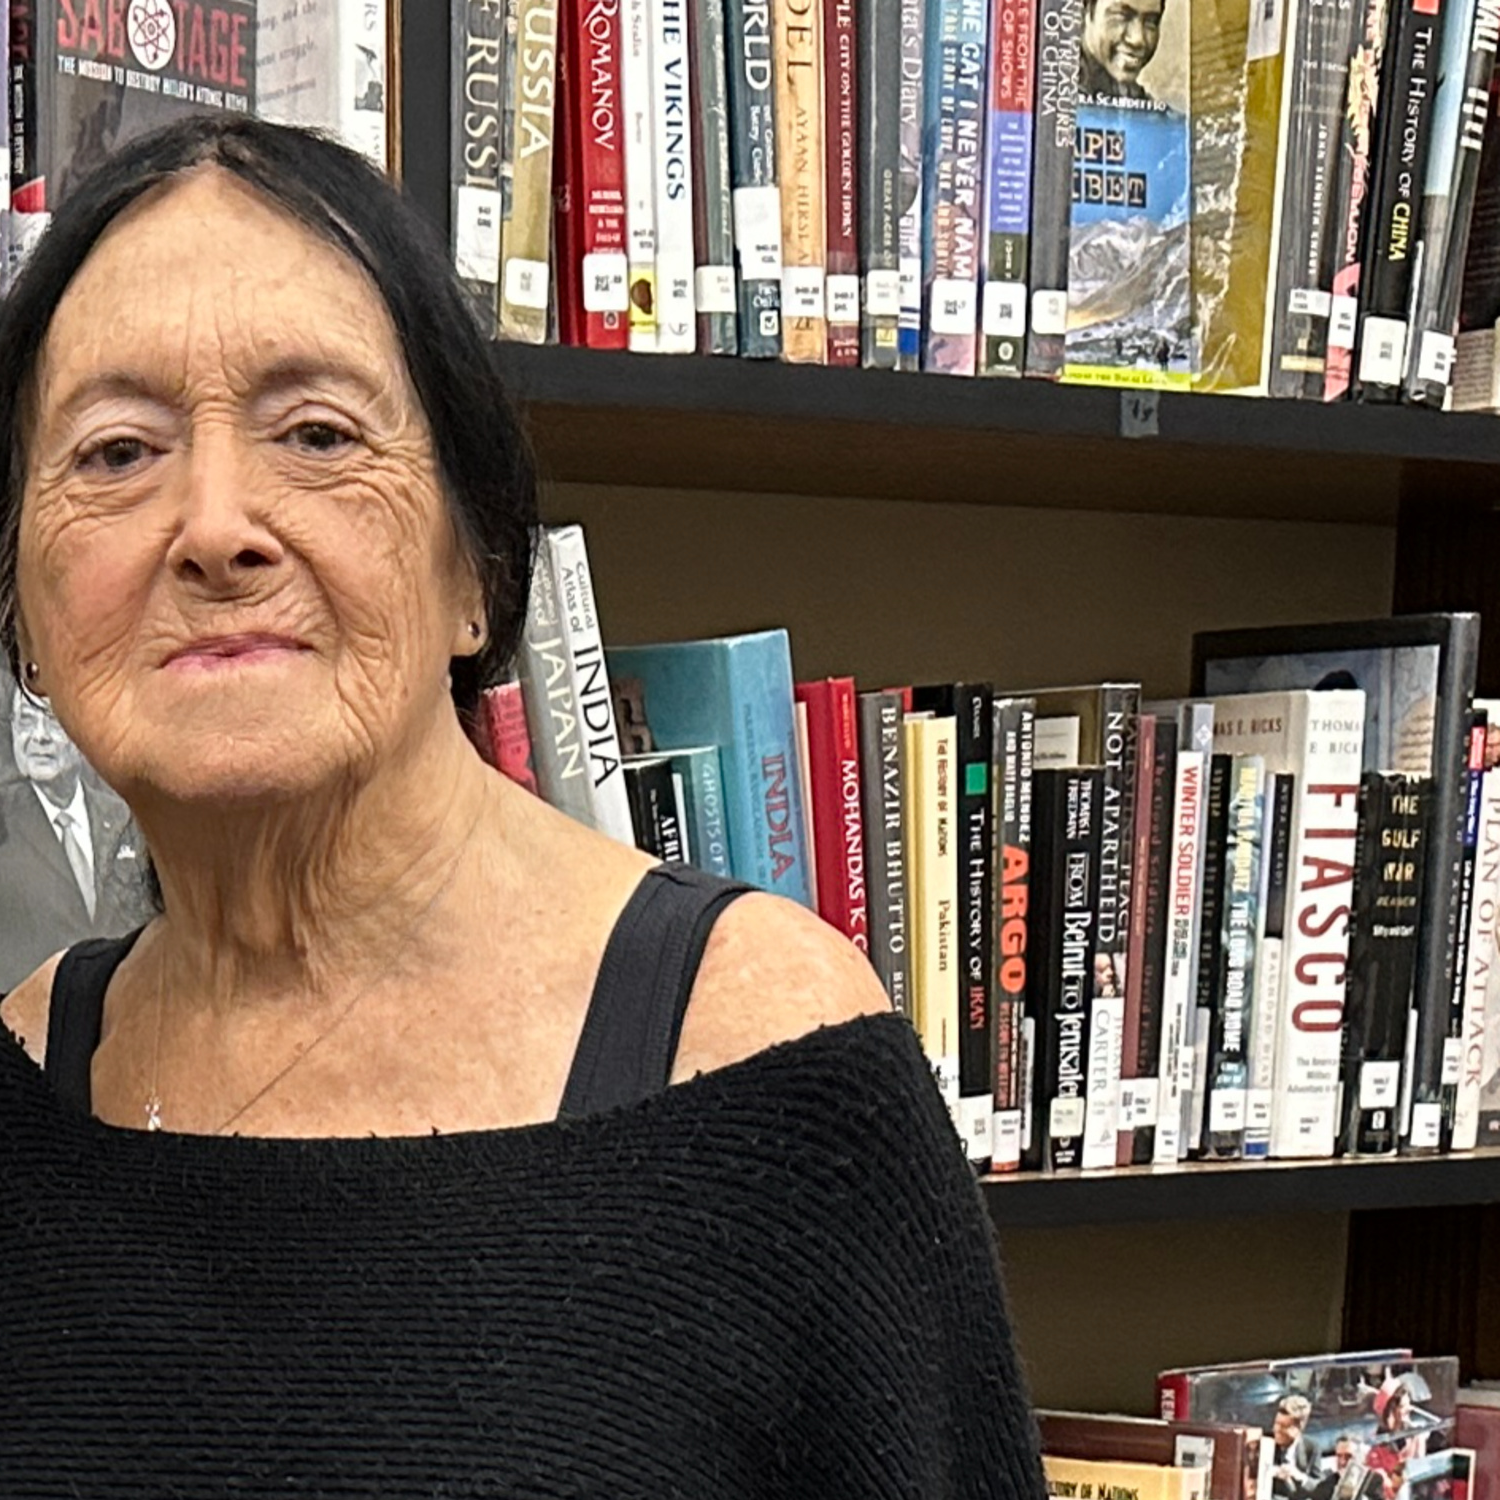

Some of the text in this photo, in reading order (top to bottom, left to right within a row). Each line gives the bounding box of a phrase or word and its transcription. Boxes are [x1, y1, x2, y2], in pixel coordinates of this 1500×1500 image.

[58, 55, 75, 75] THE
[519, 0, 557, 158] USSIA
[583, 0, 617, 151] ROMANOV
[839, 33, 850, 72] CITY
[960, 43, 979, 89] CAT
[1001, 40, 1013, 98] SNOWS
[1016, 24, 1028, 69] FROM
[1042, 11, 1059, 116] OF CHINA
[664, 58, 686, 200] VIKINGS
[899, 55, 921, 127] Diary
[1015, 75, 1028, 105] THE
[954, 119, 978, 206] NEVER
[1388, 26, 1433, 262] THE HISTORY OF CHINA
[561, 566, 584, 634] Atlas of
[575, 561, 595, 630] Cultural
[529, 635, 584, 780] JAPAN
[572, 642, 620, 789] INDIA
[1020, 711, 1034, 775] ANTONIO
[1250, 718, 1282, 734] RICKS
[702, 763, 722, 838] GHOSTS
[760, 751, 795, 883] INDIA
[841, 759, 865, 900] MOHANDAS
[881, 706, 905, 953] BENAZIR BHUTTO
[1099, 712, 1123, 942] NOT APARTHEID
[1175, 765, 1198, 916] WINTER SOLDIER
[1381, 829, 1422, 848] GULF
[1391, 795, 1418, 815] THE
[850, 906, 866, 928] K
[938, 899, 952, 972] Pakistan
[969, 807, 986, 1030] THE HISTORY OF IRAN
[1000, 843, 1029, 993] ARGO
[1062, 851, 1093, 1011] FROM Beirut TO
[1291, 783, 1359, 1034] FIASCO
[1464, 797, 1500, 1089] PLAN OF ATTACK
[1092, 1009, 1111, 1094] CARTER
[1081, 1486, 1094, 1500] OF
